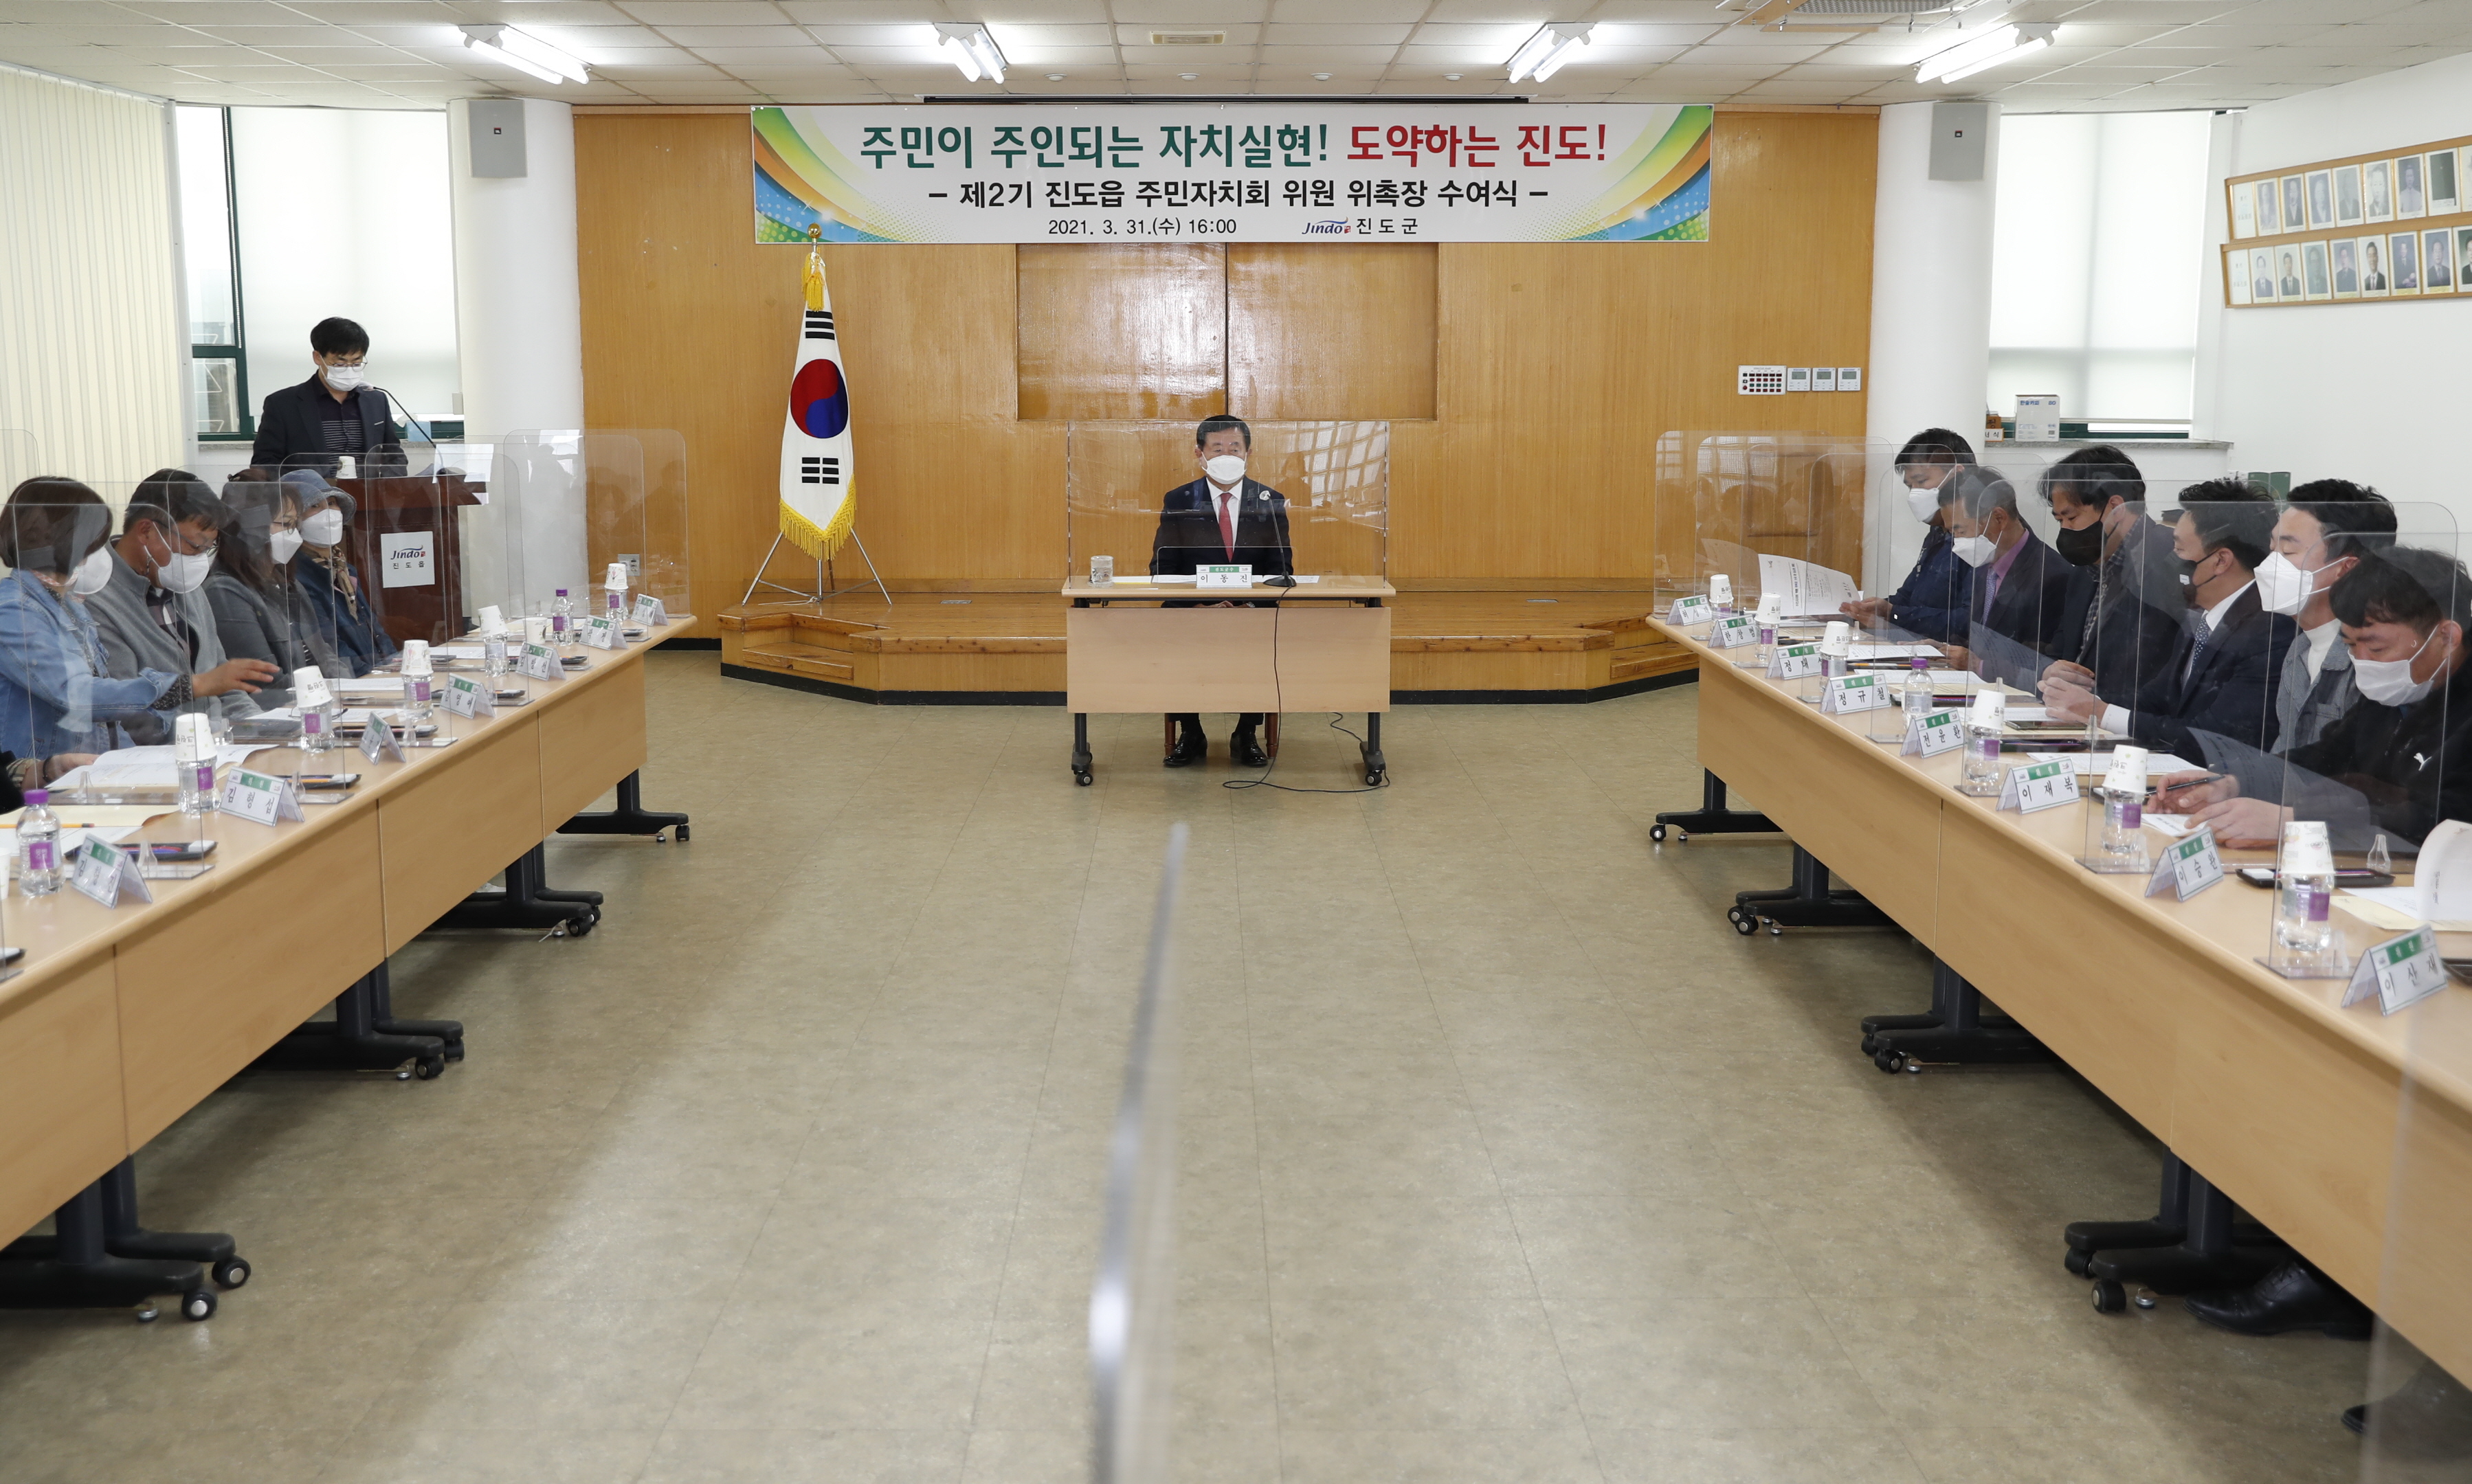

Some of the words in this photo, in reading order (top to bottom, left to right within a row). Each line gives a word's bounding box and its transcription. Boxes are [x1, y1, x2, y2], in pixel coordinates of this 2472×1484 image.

[861, 126, 972, 169] 주민이
[990, 126, 1144, 168] 주인되는
[1159, 124, 1327, 168] 자치실현!
[1347, 124, 1500, 168] 도약하는
[1517, 124, 1606, 167] 진도!
[959, 181, 1032, 208] 제2기
[1045, 180, 1125, 208] 진도읍
[1135, 180, 1269, 208] 주민자치회
[1282, 179, 1335, 207] 위원
[1347, 179, 1428, 207] 위촉장
[1437, 180, 1517, 207] 수여식
[1049, 219, 1093, 235] 2021.
[1103, 219, 1118, 235] 3.
[1126, 217, 1181, 236] 31.(수)
[1189, 218, 1236, 234] 16:00
[1302, 222, 1343, 235] Jindo
[390, 550, 420, 560] Jindo
